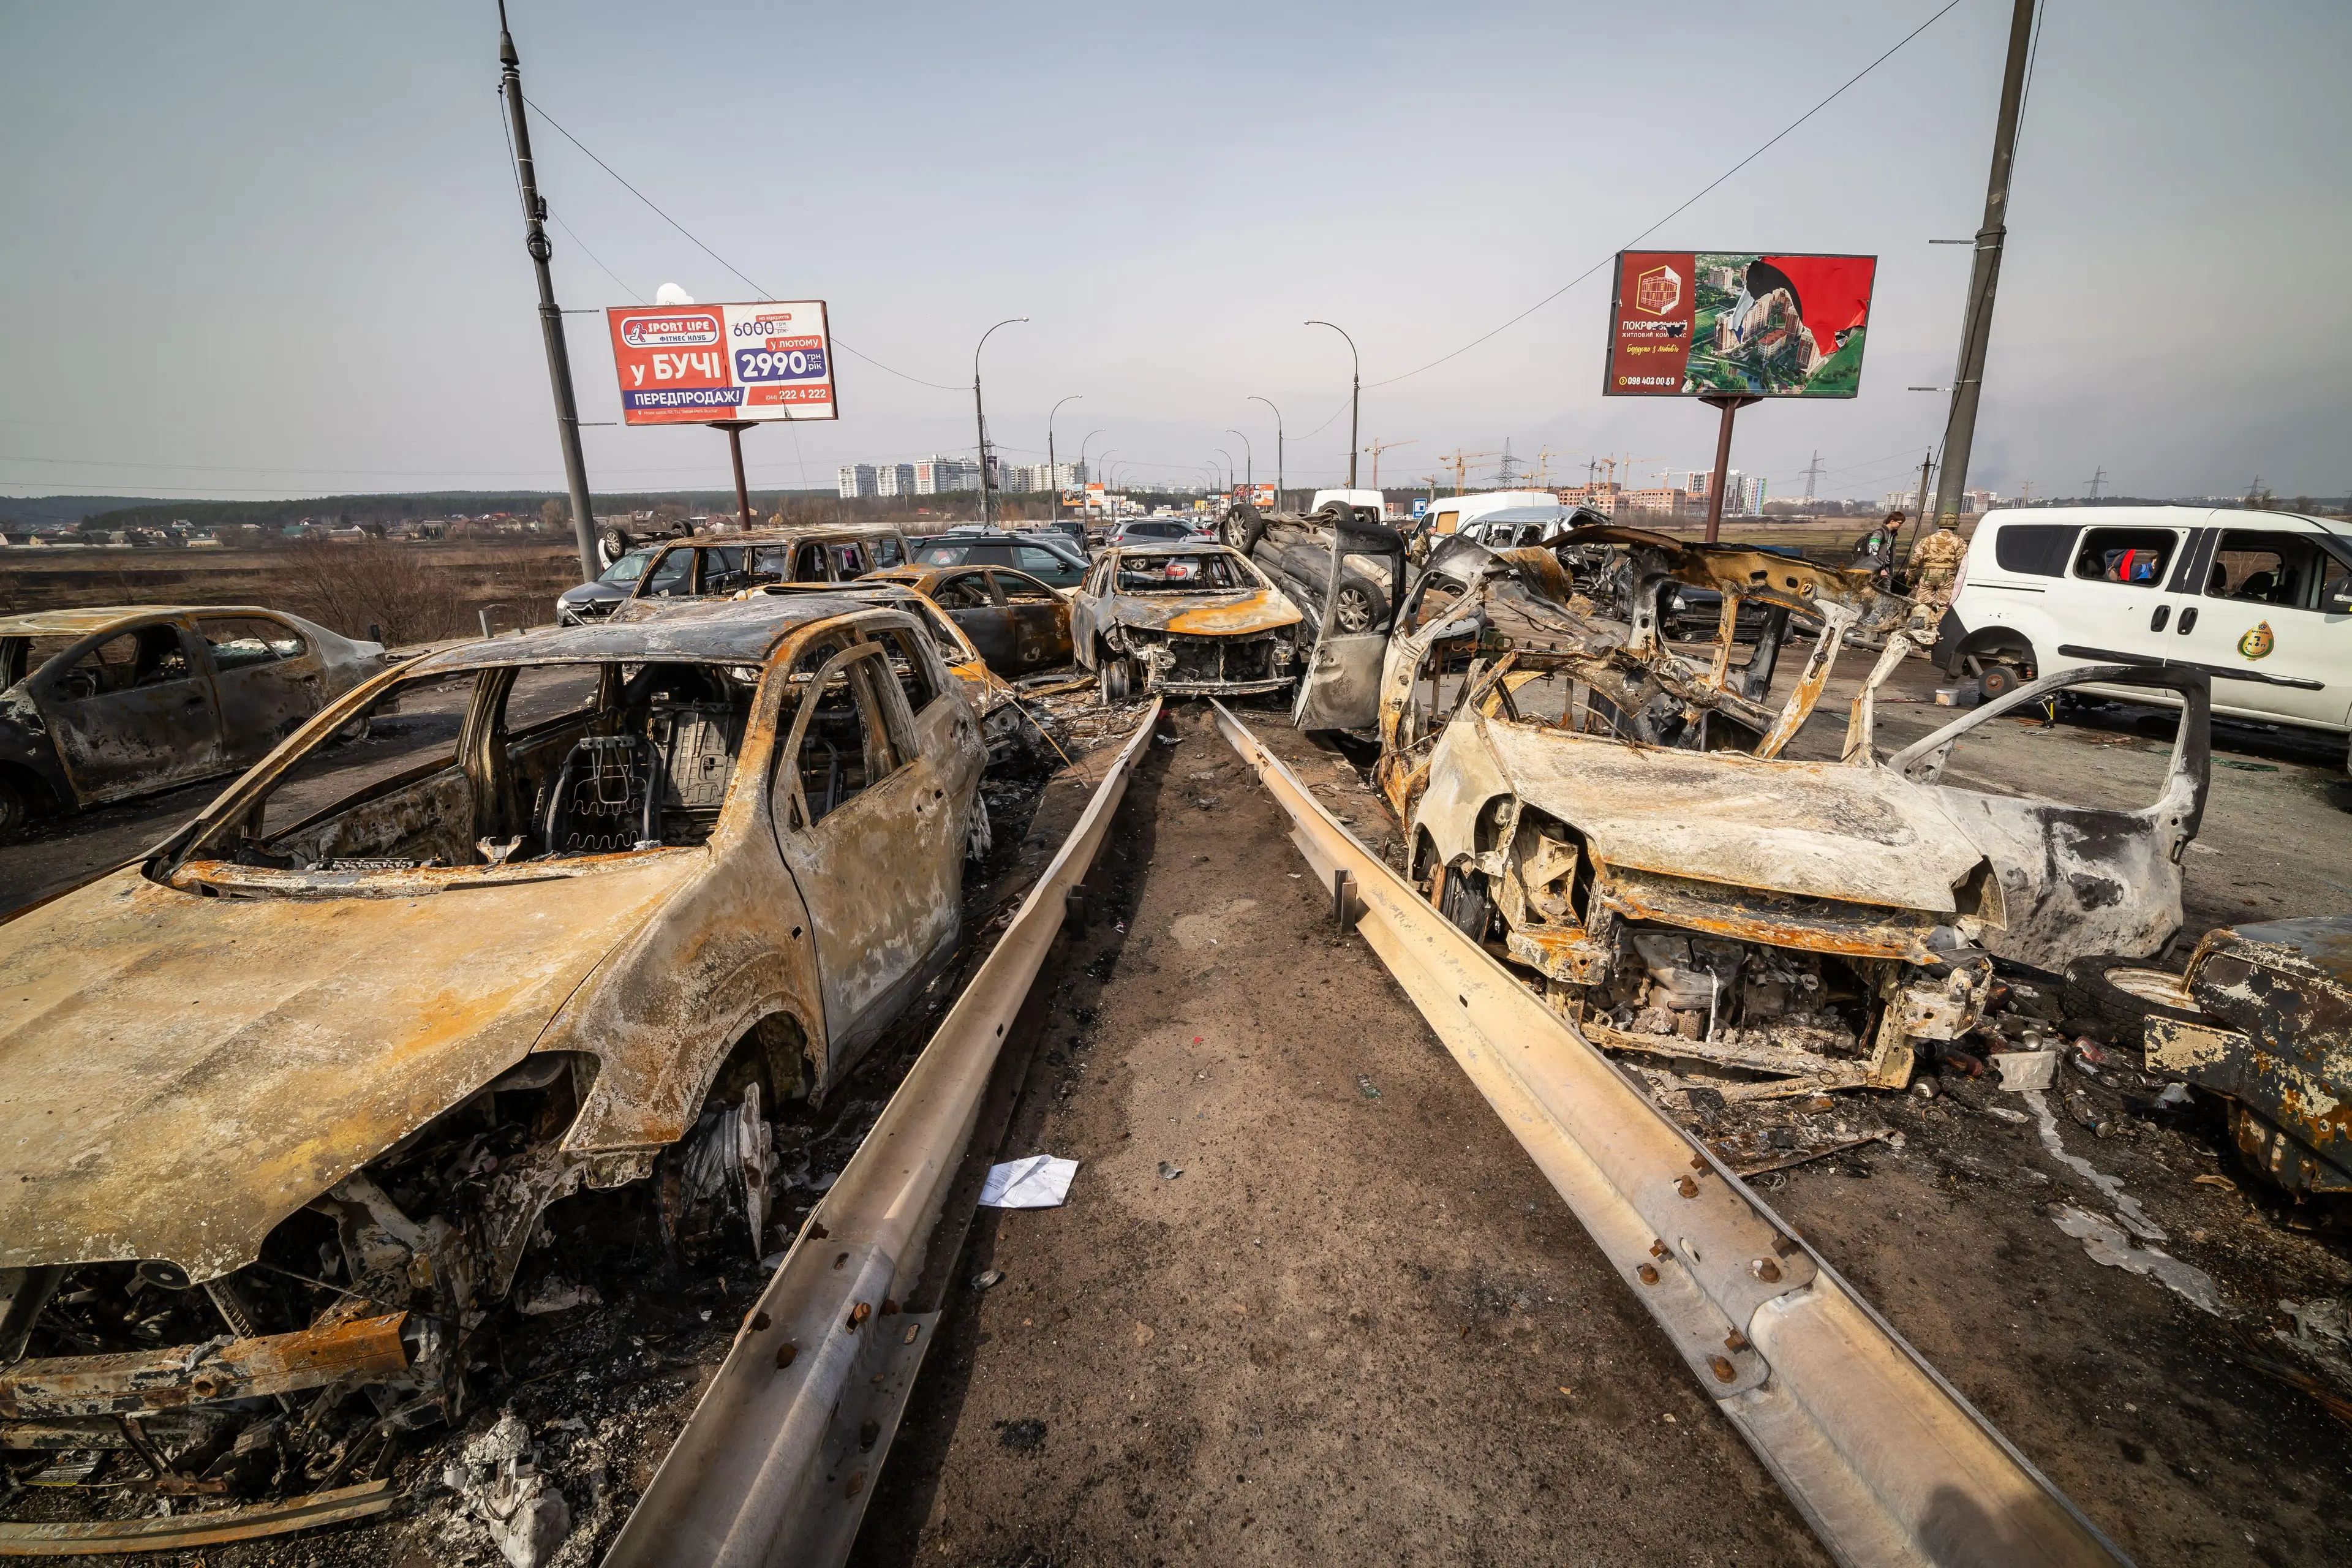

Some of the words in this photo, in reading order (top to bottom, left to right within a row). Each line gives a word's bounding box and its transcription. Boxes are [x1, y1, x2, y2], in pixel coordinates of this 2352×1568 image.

[648, 322, 684, 333] SPORT
[687, 321, 709, 331] LIFE
[734, 321, 774, 337] 6000
[778, 339, 818, 349] ЛЮТОМУ
[652, 352, 721, 380] БУЧІ
[741, 351, 807, 377] 2990
[808, 363, 822, 371] рік
[1656, 377, 1665, 385] 00
[635, 391, 739, 405] ПЕРЕДПРОДАЖ!
[779, 390, 797, 399] 222
[799, 390, 805, 399] 4
[808, 389, 826, 398] 222
